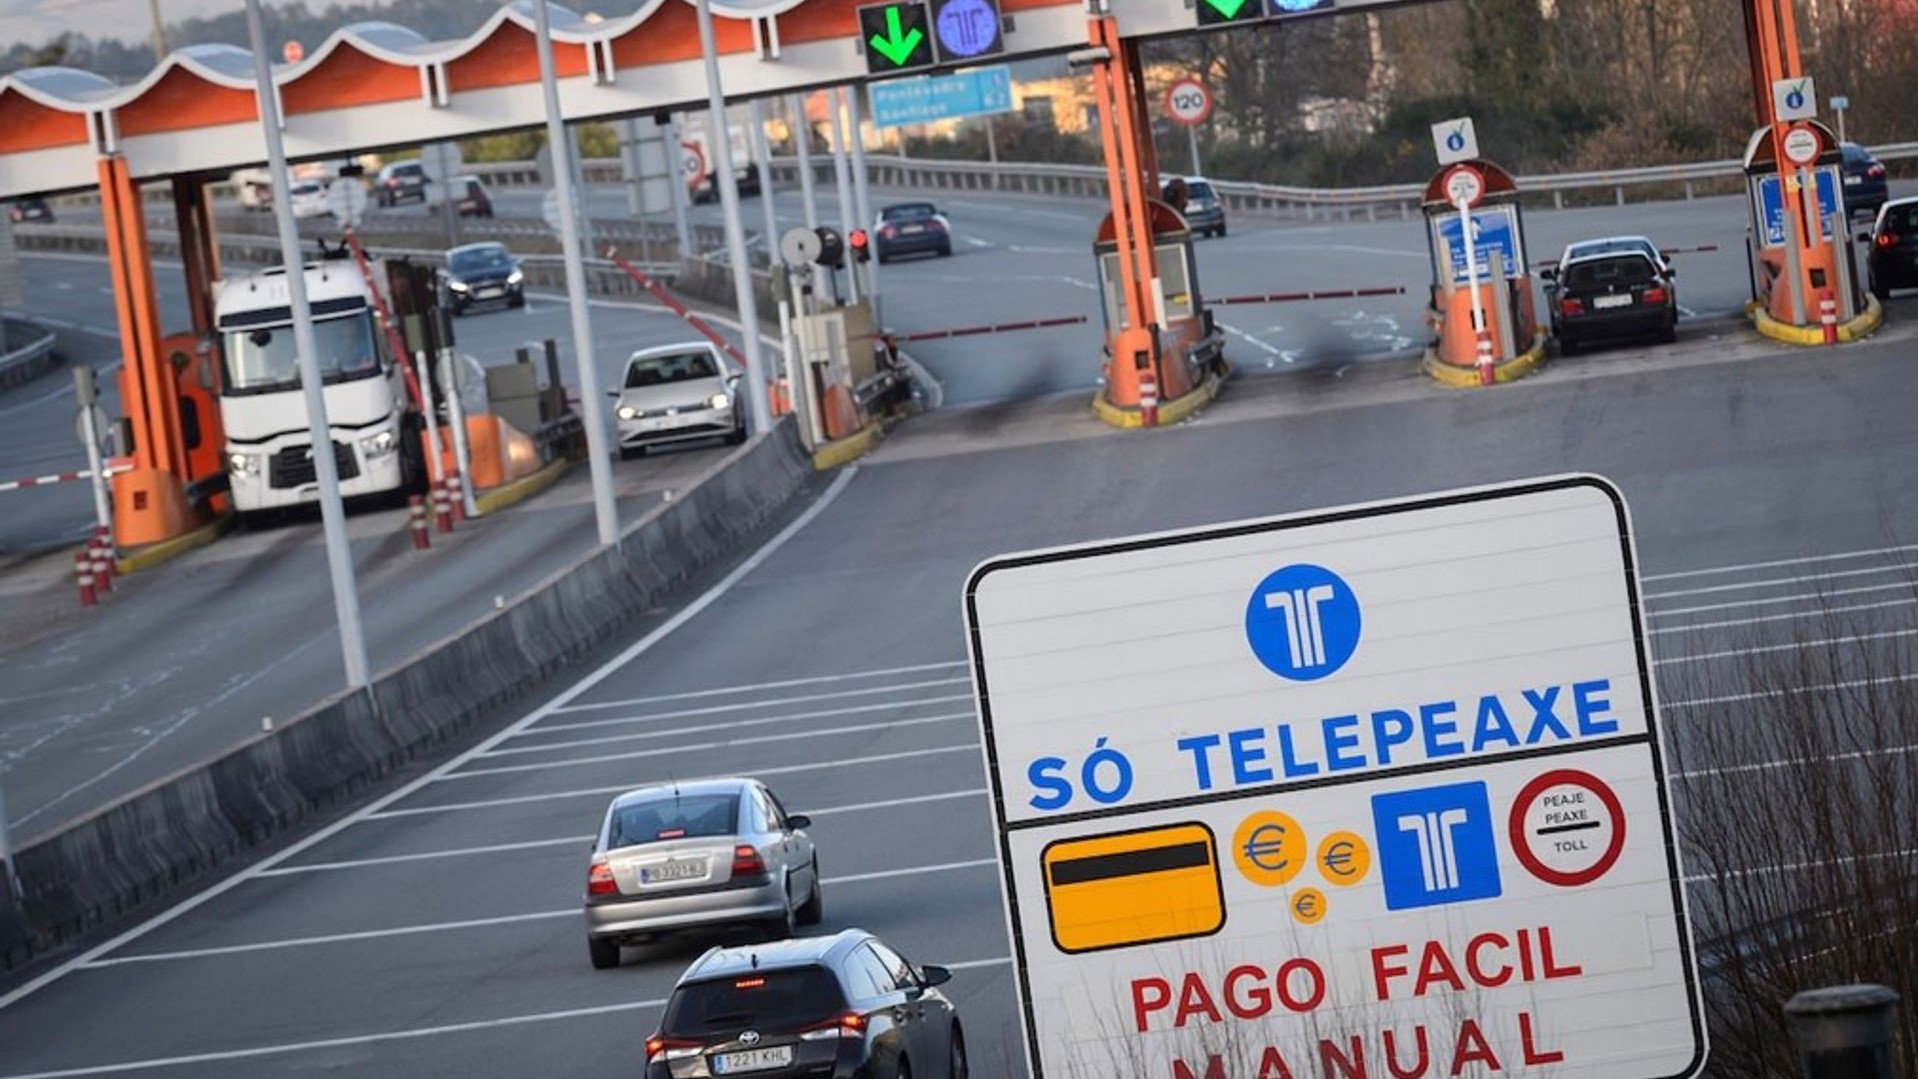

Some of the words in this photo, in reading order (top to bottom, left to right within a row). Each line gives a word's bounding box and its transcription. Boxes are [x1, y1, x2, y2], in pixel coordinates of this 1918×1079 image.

[1173, 92, 1204, 110] 120
[1027, 738, 1133, 810] SÓ
[1178, 679, 1619, 790] TELEPEAXE
[1543, 792, 1585, 807] PEAJE
[1545, 809, 1588, 824] PEAXE
[1554, 839, 1589, 852] TOLL
[1131, 957, 1327, 1033] PAGO
[1371, 925, 1582, 1001] FACIL
[725, 1051, 758, 1068] 1221
[762, 1048, 788, 1062] KHL
